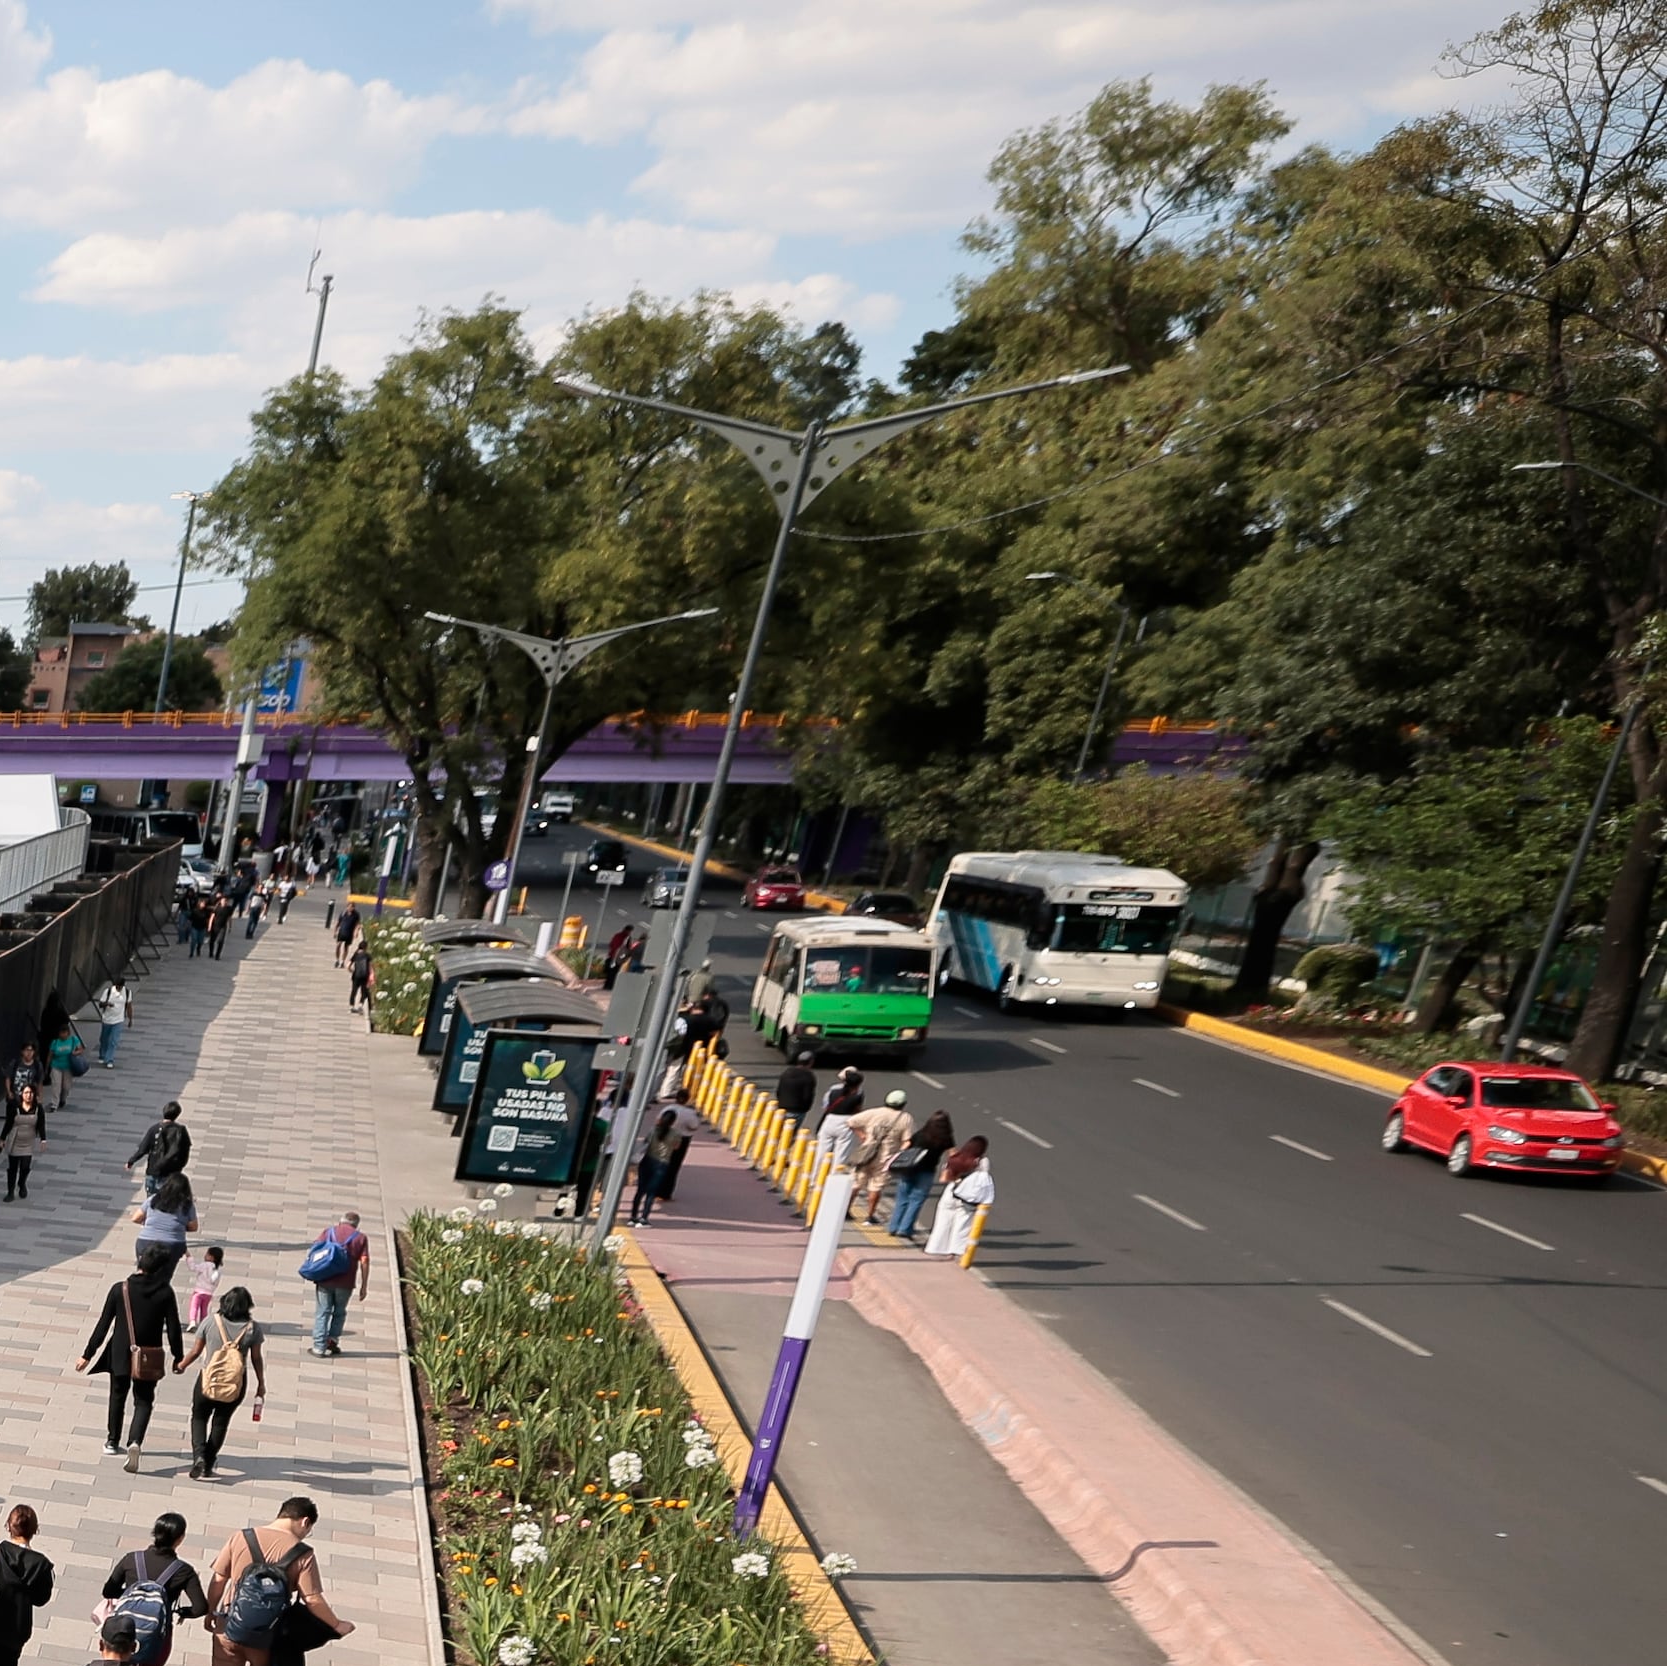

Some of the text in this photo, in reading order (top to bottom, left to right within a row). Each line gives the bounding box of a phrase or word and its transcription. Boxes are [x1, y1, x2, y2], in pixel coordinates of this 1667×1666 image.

[505, 1088, 565, 1101] TUS PILAS
[497, 1098, 566, 1113] USADAS NO
[492, 1107, 519, 1118] SON
